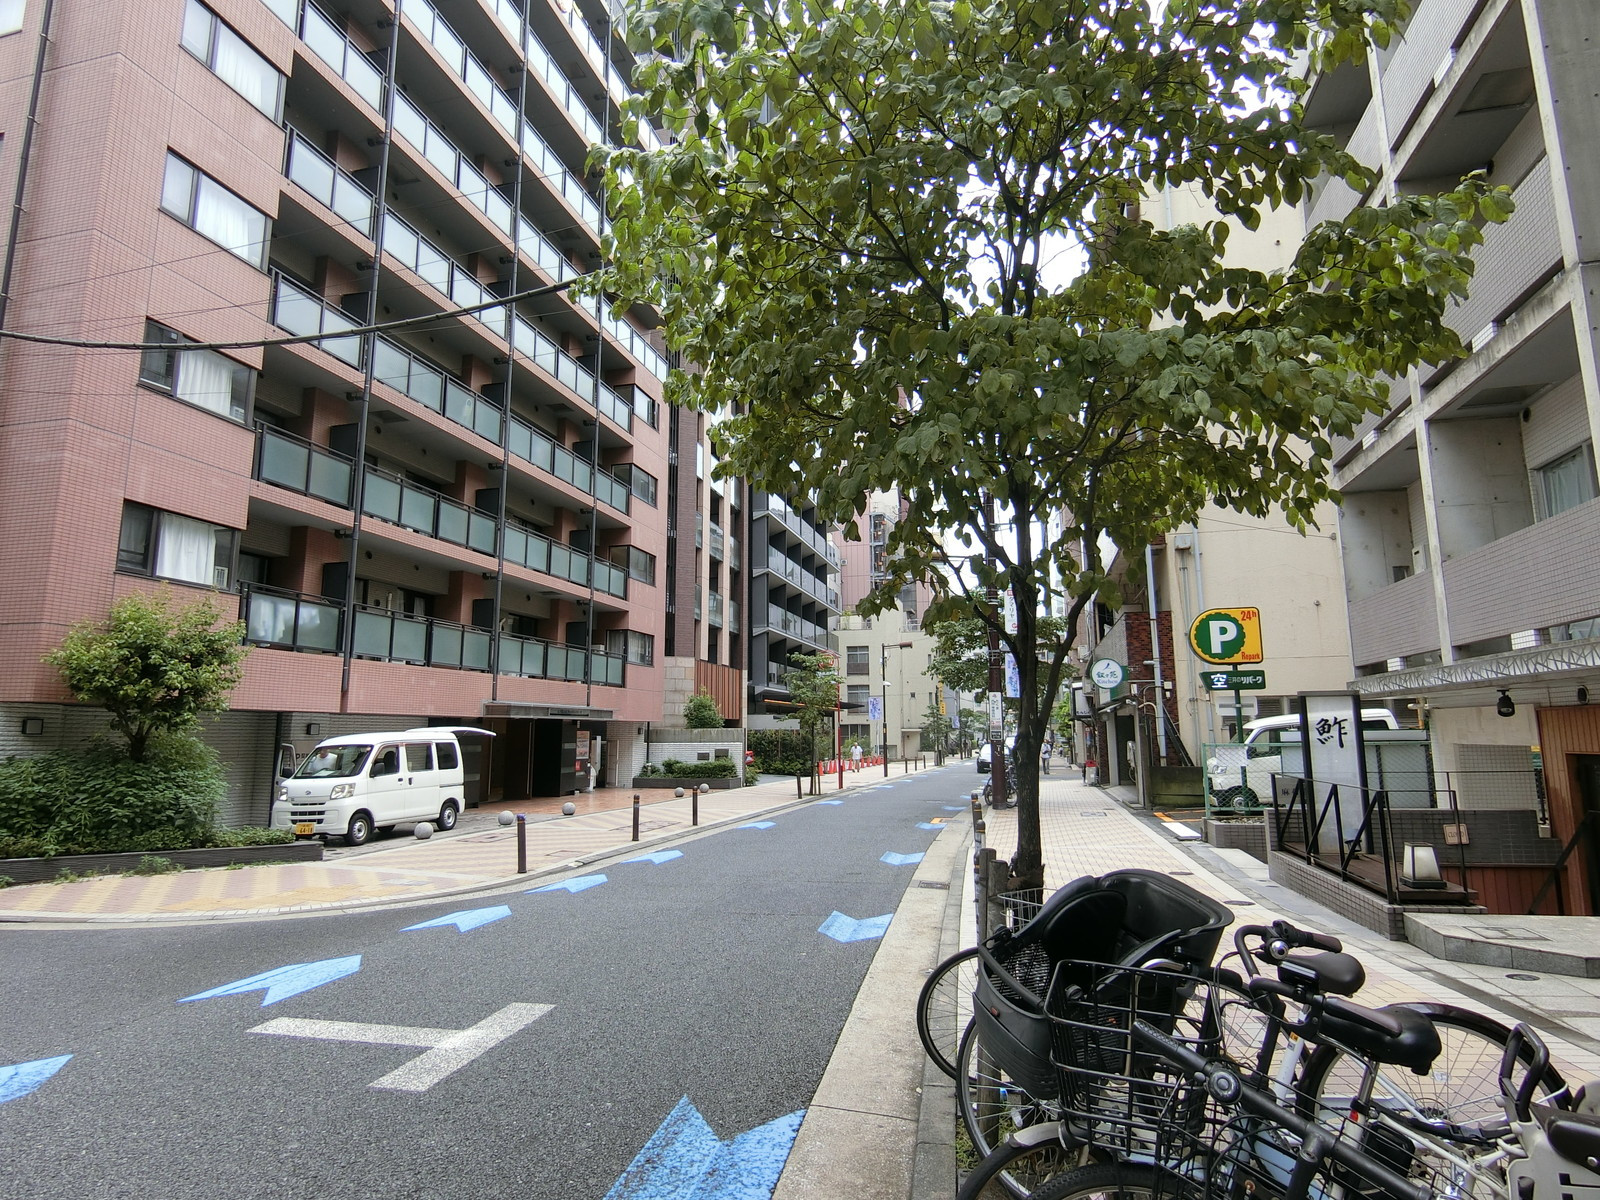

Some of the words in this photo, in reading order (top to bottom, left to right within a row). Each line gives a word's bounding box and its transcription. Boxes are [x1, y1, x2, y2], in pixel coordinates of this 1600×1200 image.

[1240, 610, 1257, 622] 24h
[1208, 620, 1238, 654] P
[1241, 651, 1261, 661] Repark
[1210, 673, 1228, 689] 空
[1228, 675, 1263, 685] 三井のリパーク
